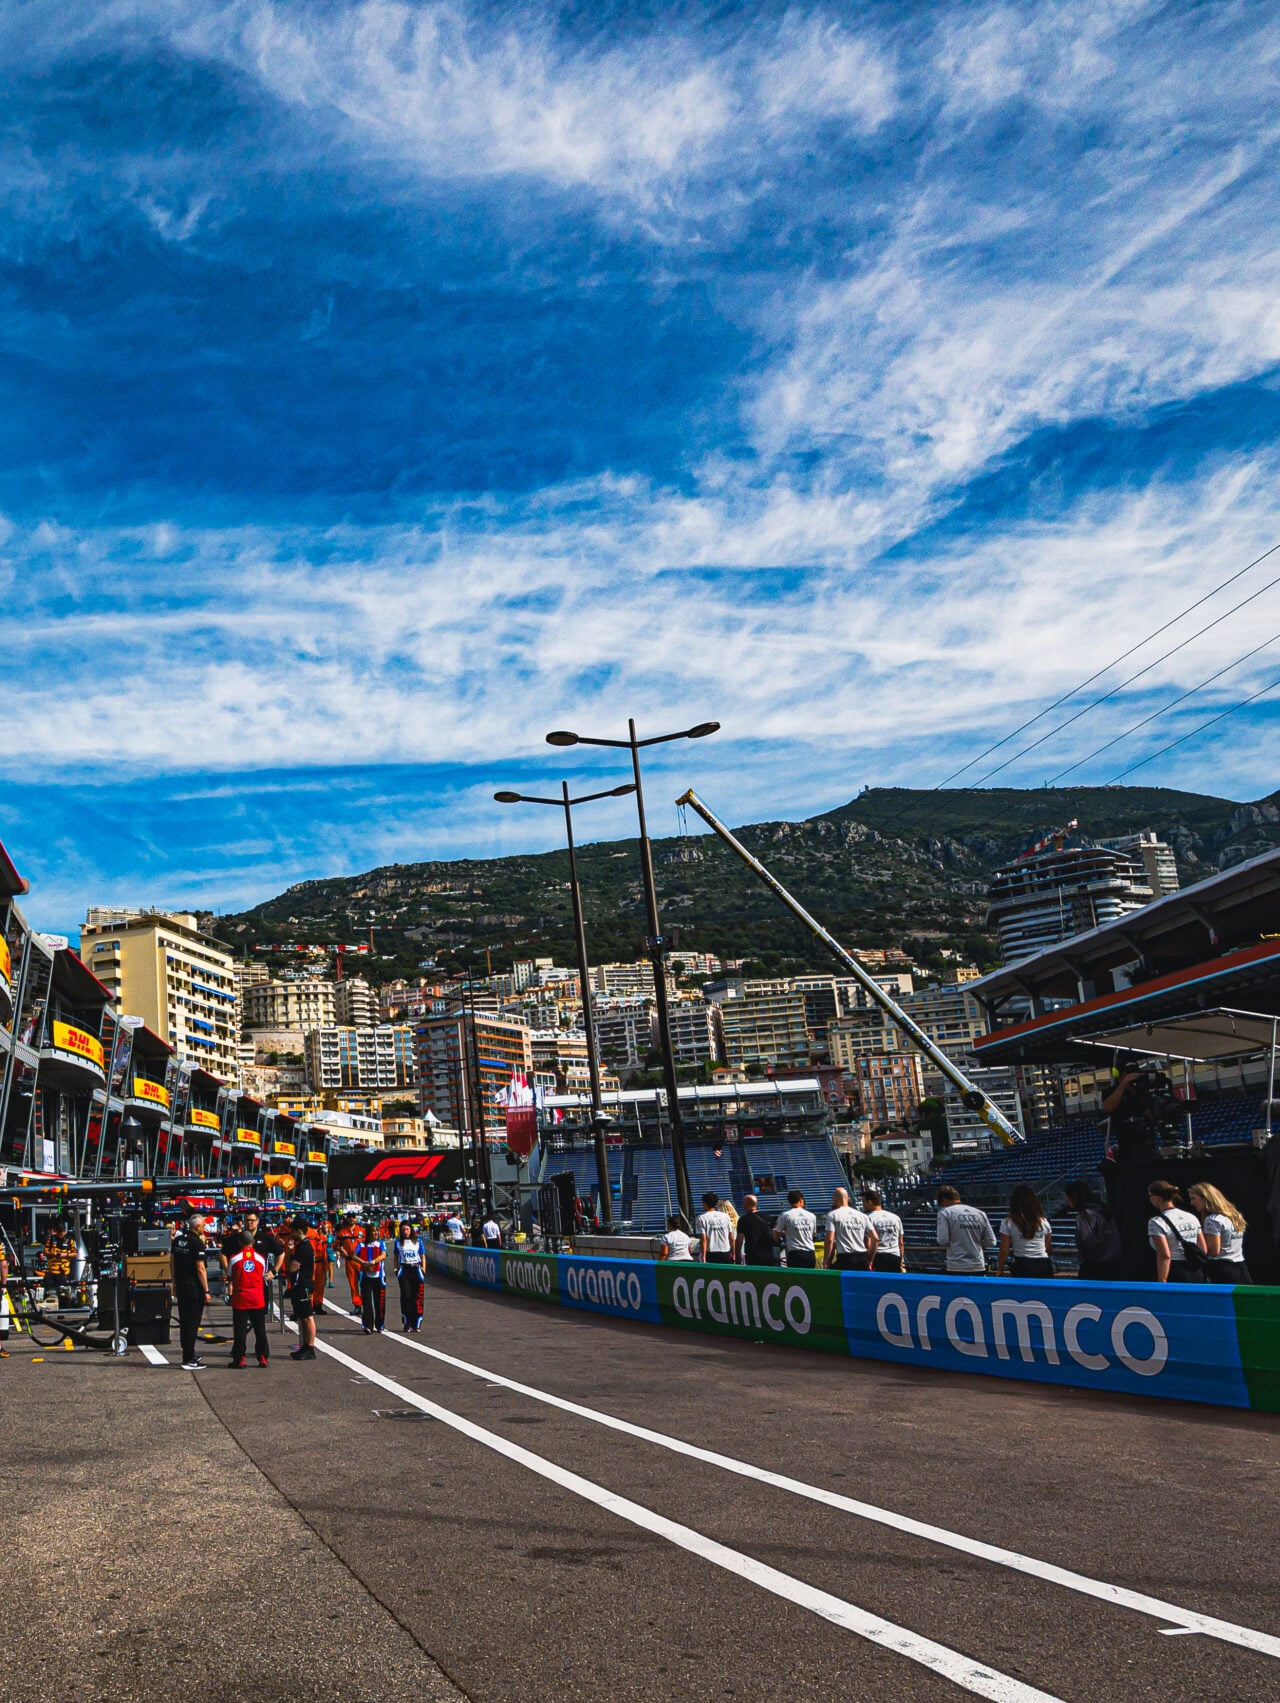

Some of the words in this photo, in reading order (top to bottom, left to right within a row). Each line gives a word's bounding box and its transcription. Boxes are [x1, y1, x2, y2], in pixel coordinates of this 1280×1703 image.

[68, 1029, 91, 1054] DHL
[364, 1155, 446, 1180] F1
[506, 1259, 551, 1295] aramco
[567, 1266, 641, 1310] aramco
[672, 1275, 812, 1335] aramco
[875, 1291, 1169, 1377] aramco
